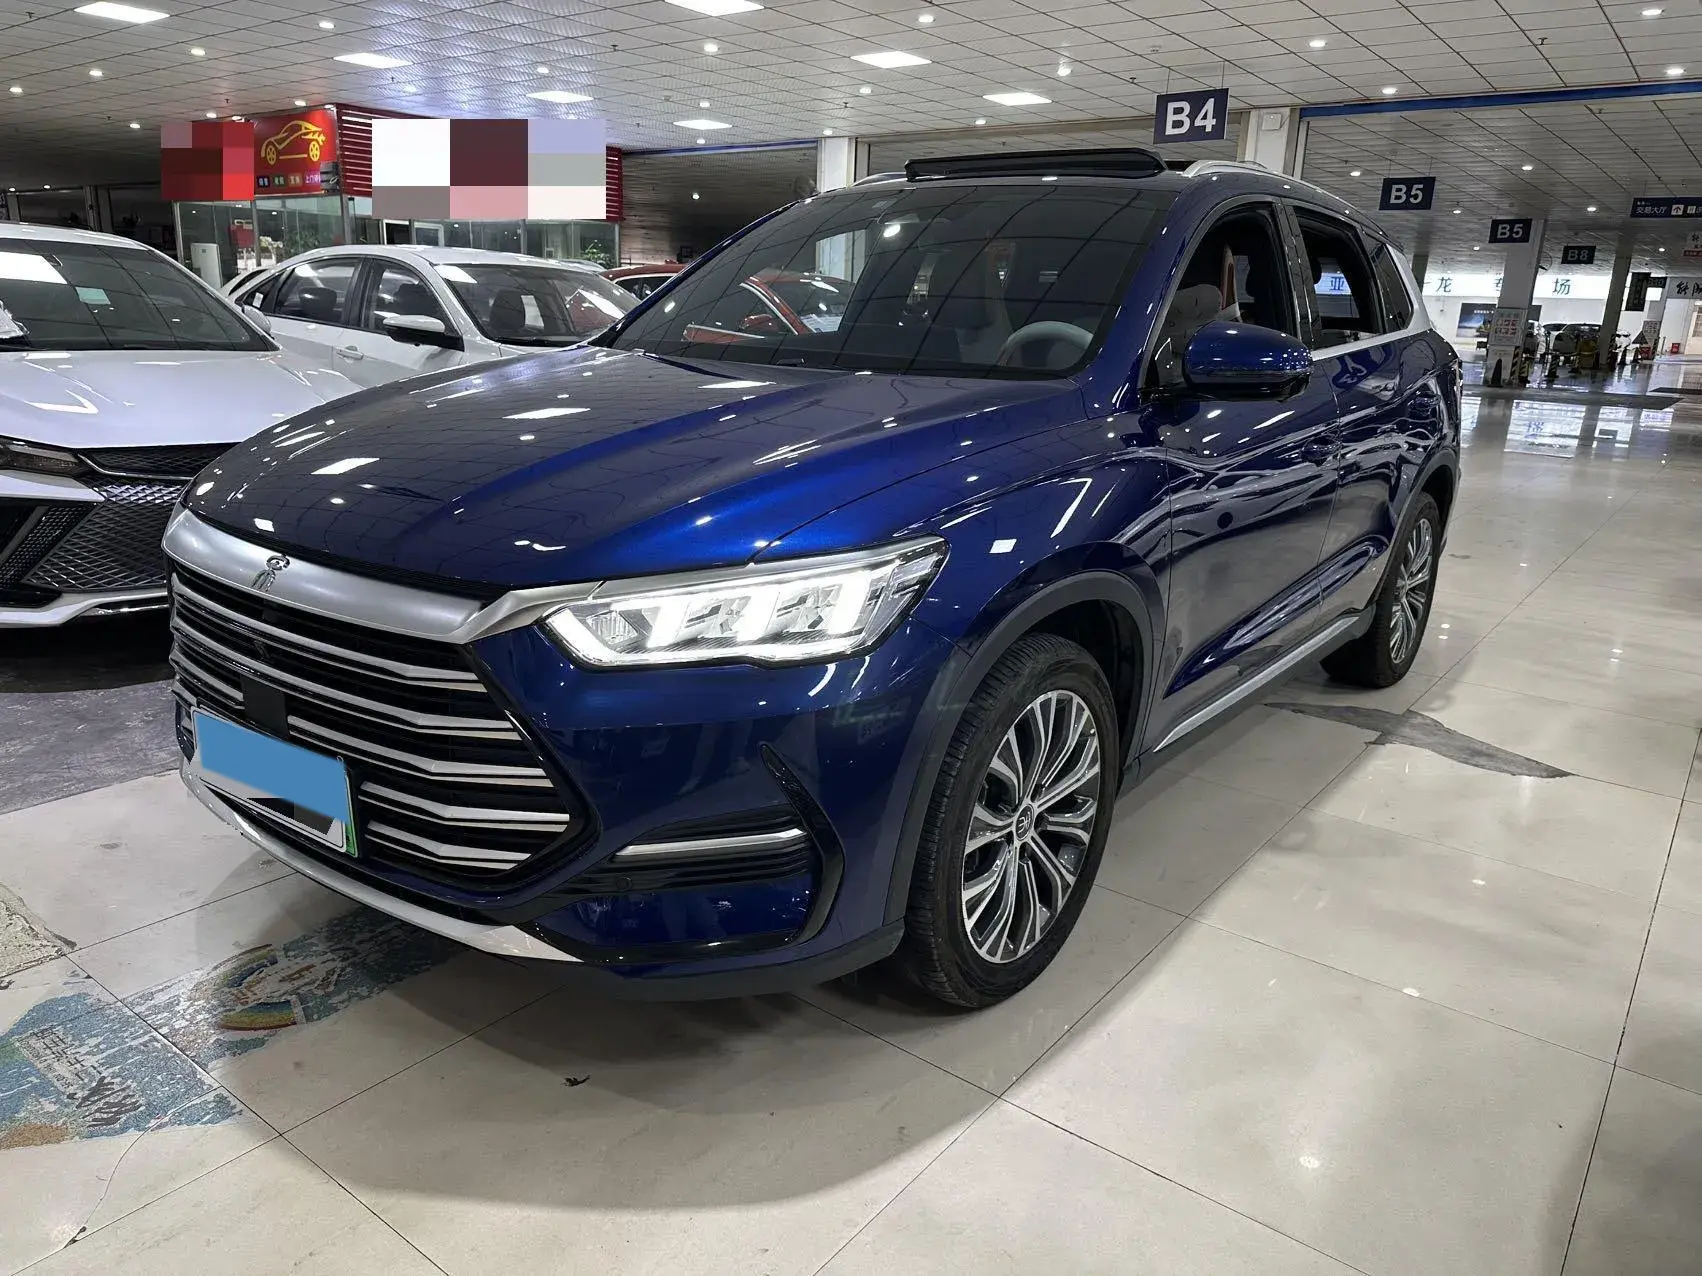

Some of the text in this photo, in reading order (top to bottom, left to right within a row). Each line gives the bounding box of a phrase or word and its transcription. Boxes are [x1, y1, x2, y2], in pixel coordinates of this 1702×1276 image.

[1165, 98, 1216, 135] B4
[1389, 184, 1424, 204] B5
[1497, 223, 1523, 239] B5
[1567, 249, 1589, 261] B8
